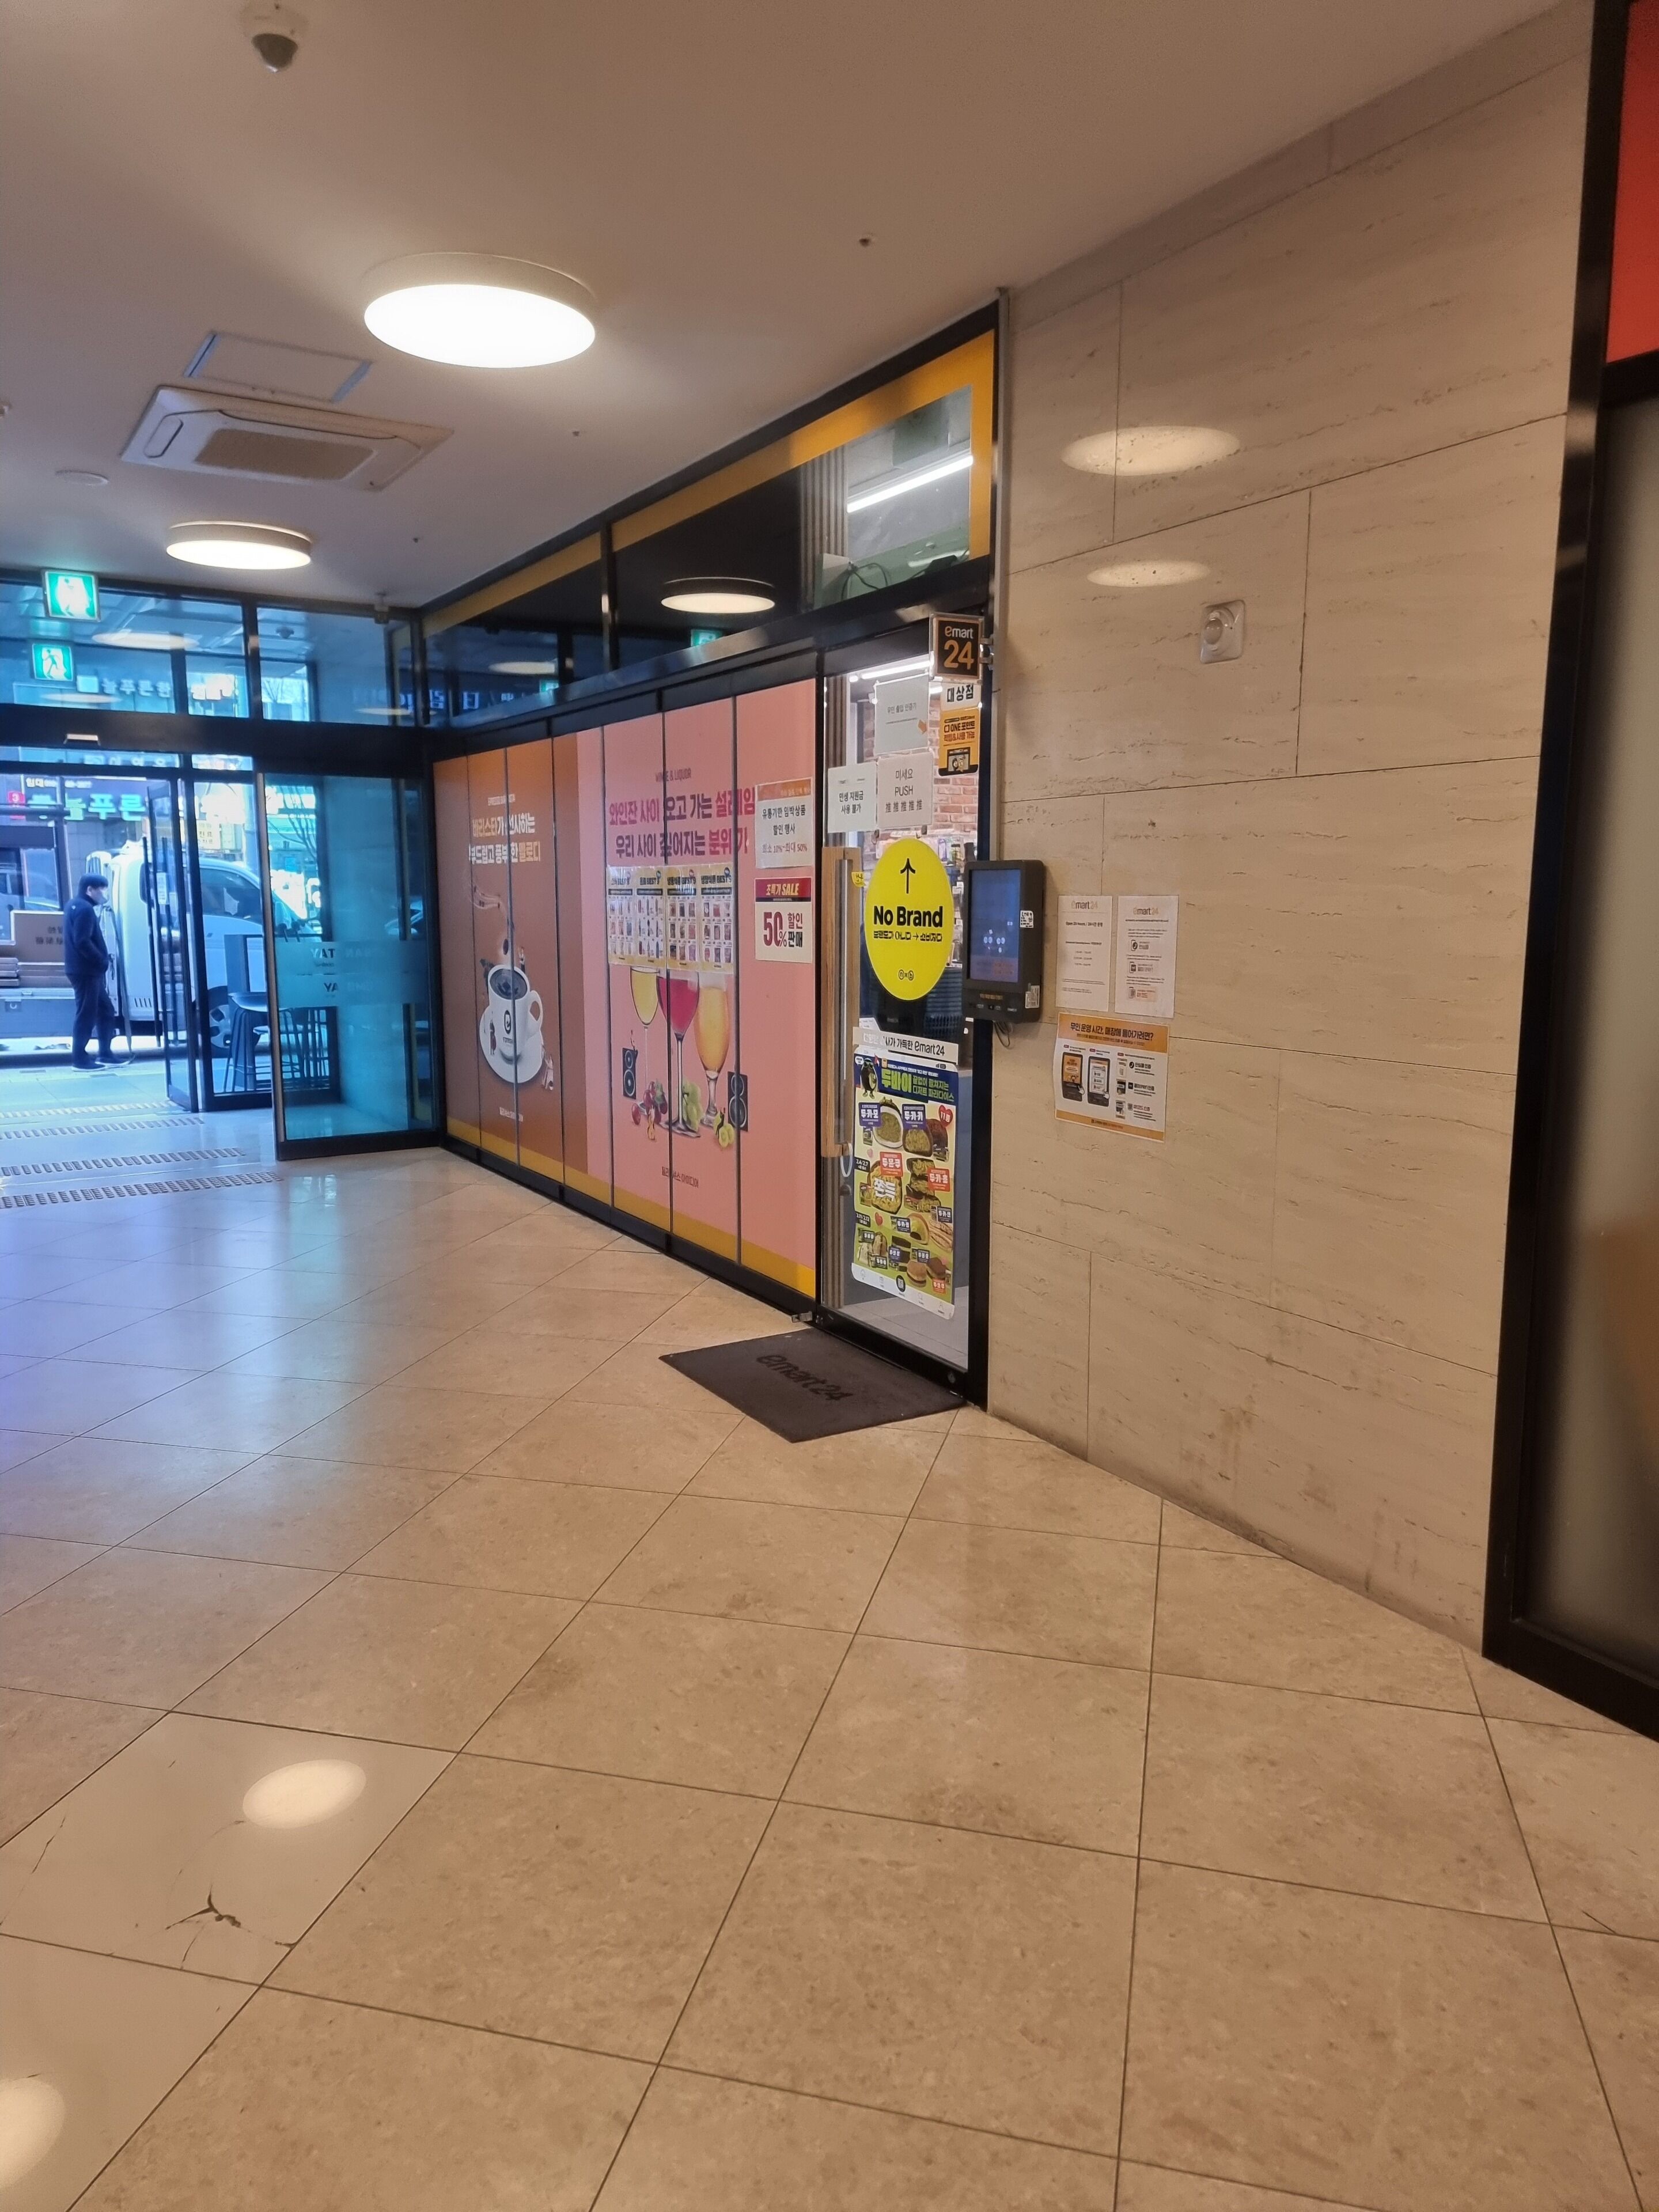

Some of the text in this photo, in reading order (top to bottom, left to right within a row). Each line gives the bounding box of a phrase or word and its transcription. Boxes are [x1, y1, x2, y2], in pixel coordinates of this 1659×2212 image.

[945, 626, 974, 639] emart
[944, 639, 975, 670] 24
[946, 684, 974, 702] 대상점
[895, 768, 914, 781] 미세요
[850, 790, 863, 801] 지원금
[895, 785, 914, 797] PUSH
[609, 801, 637, 825] 와인잔
[640, 798, 660, 823] 사이
[664, 795, 687, 821] 오고
[690, 793, 712, 820] 가는
[841, 805, 850, 815] 사용
[773, 823, 796, 835] 할인 행사
[616, 835, 634, 858] 우리
[637, 833, 657, 858] 사이
[709, 827, 748, 855] 분위기
[782, 882, 800, 895] SALE
[1071, 900, 1098, 910] emart24
[787, 912, 803, 929] 할인
[873, 906, 943, 927] No Brand
[763, 911, 787, 947] 50%
[788, 931, 803, 948] 판매
[1070, 1022, 1080, 1032] 무인
[1081, 1024, 1092, 1033] 운영
[897, 1039, 913, 1051] 가득한
[914, 1040, 945, 1056] emart24
[881, 1068, 912, 1093] 두바이
[756, 1355, 854, 1401] emart24
